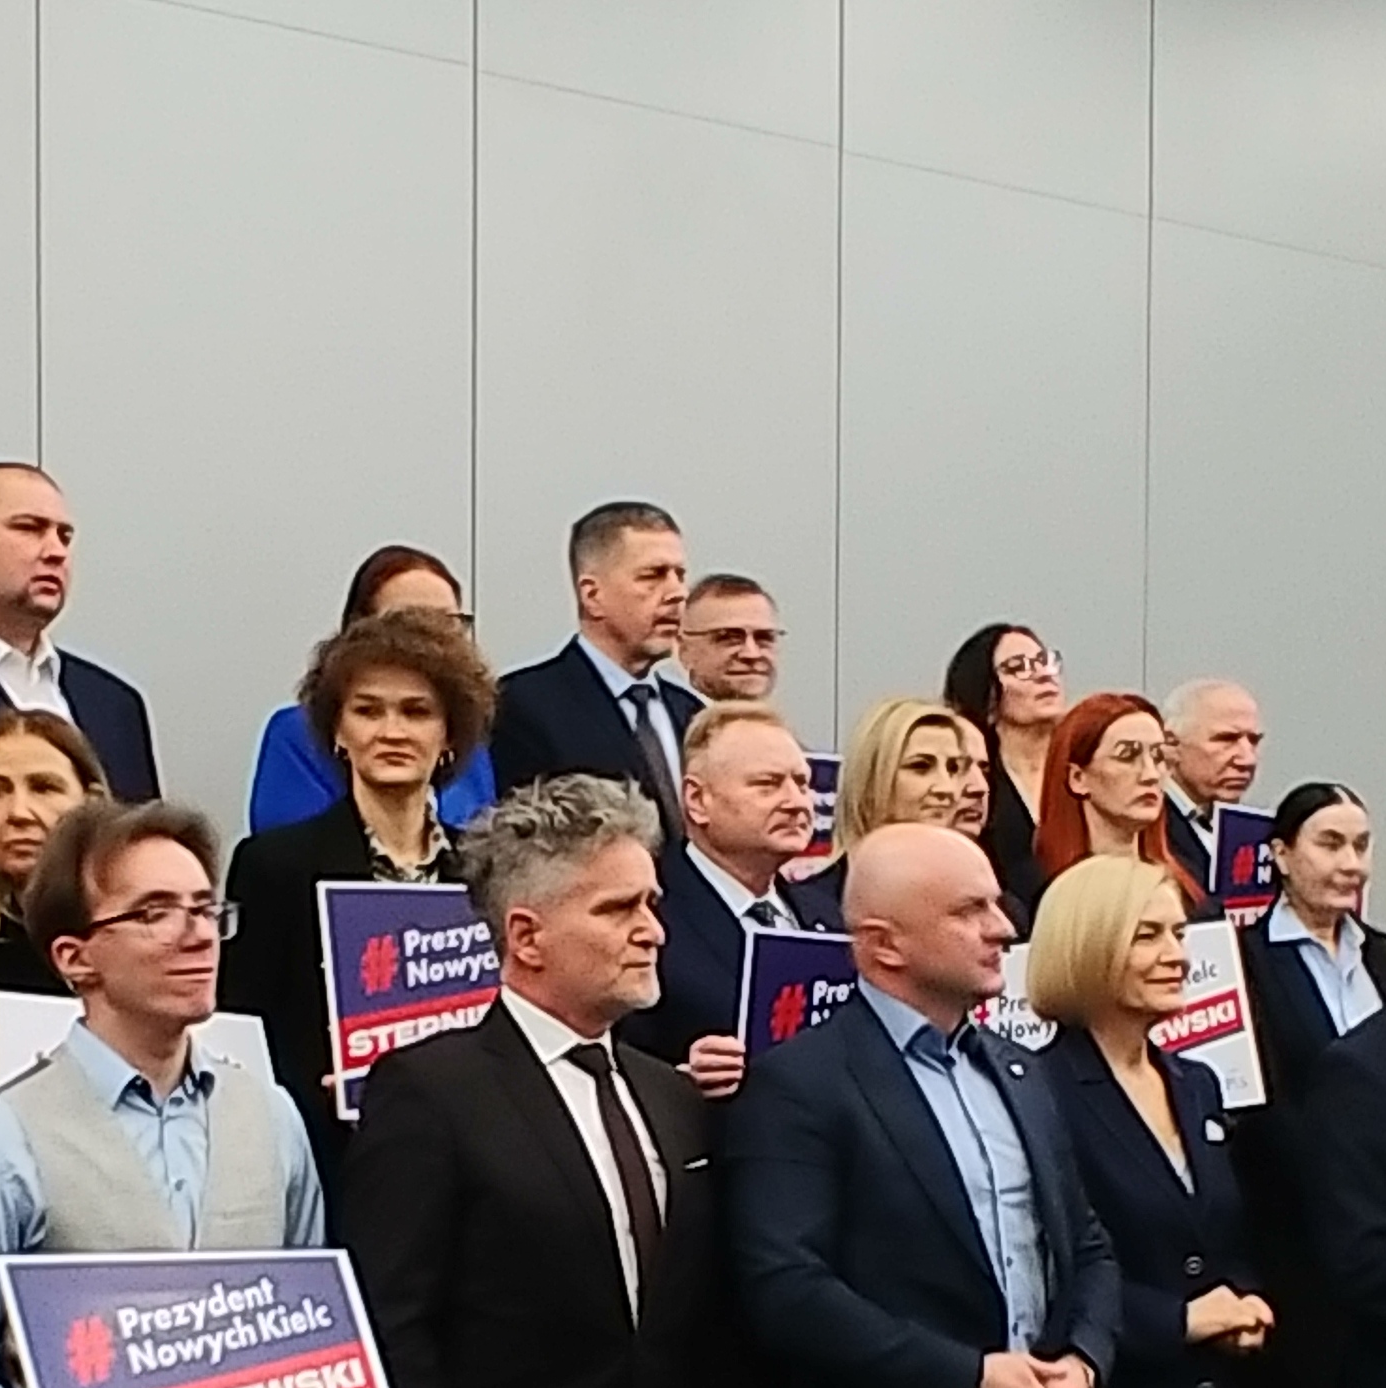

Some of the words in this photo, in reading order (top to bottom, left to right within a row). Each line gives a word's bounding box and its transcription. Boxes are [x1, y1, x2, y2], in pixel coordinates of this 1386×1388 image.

[117, 1275, 276, 1340] Prezydent
[126, 1313, 259, 1376] Nowych
[259, 1298, 333, 1342] Kielc
